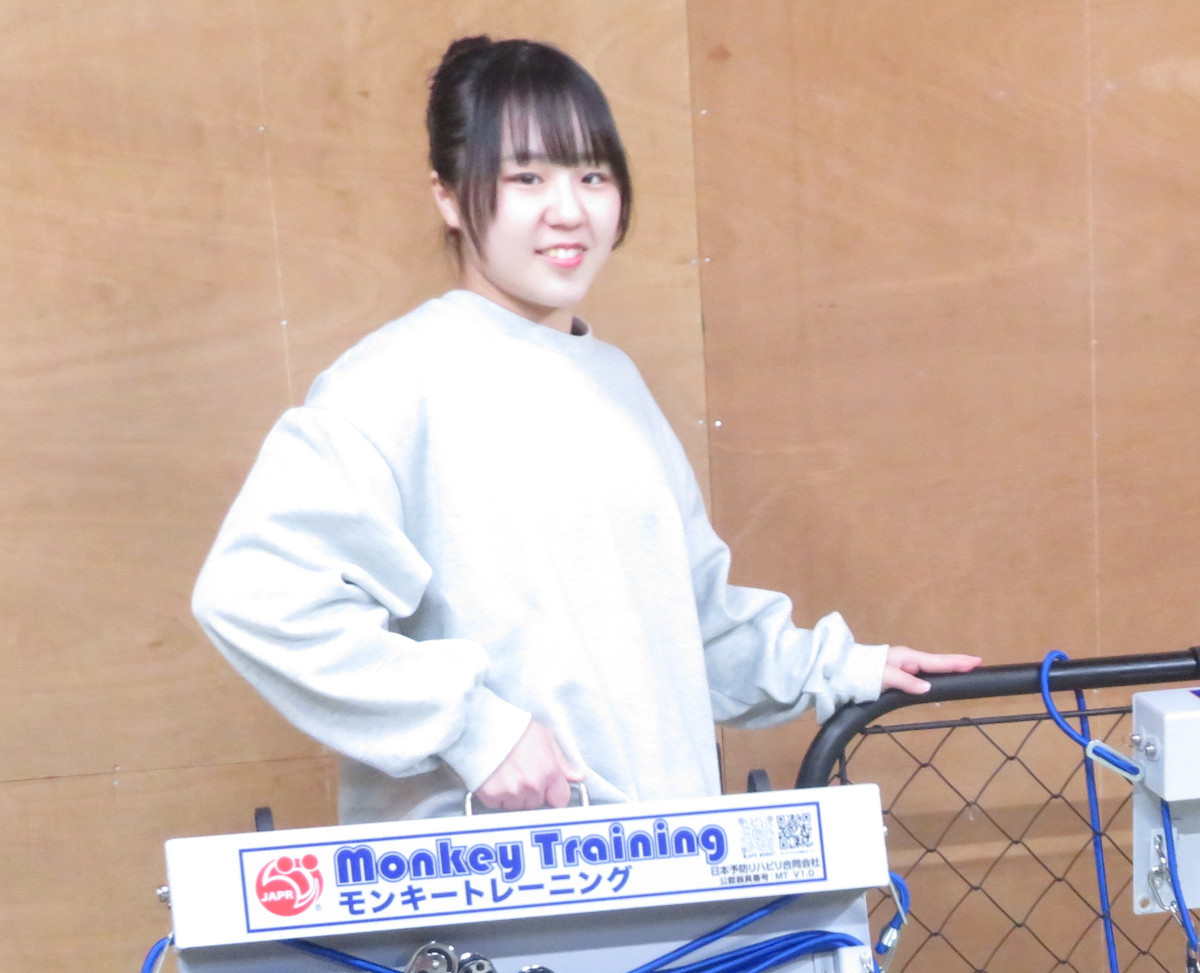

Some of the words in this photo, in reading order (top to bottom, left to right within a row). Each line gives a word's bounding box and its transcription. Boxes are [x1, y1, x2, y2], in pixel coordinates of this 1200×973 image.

[334, 838, 525, 887] Monkey
[530, 818, 729, 869] Training
[261, 889, 294, 902] JAPR
[339, 865, 632, 915] モンキートレーニング
